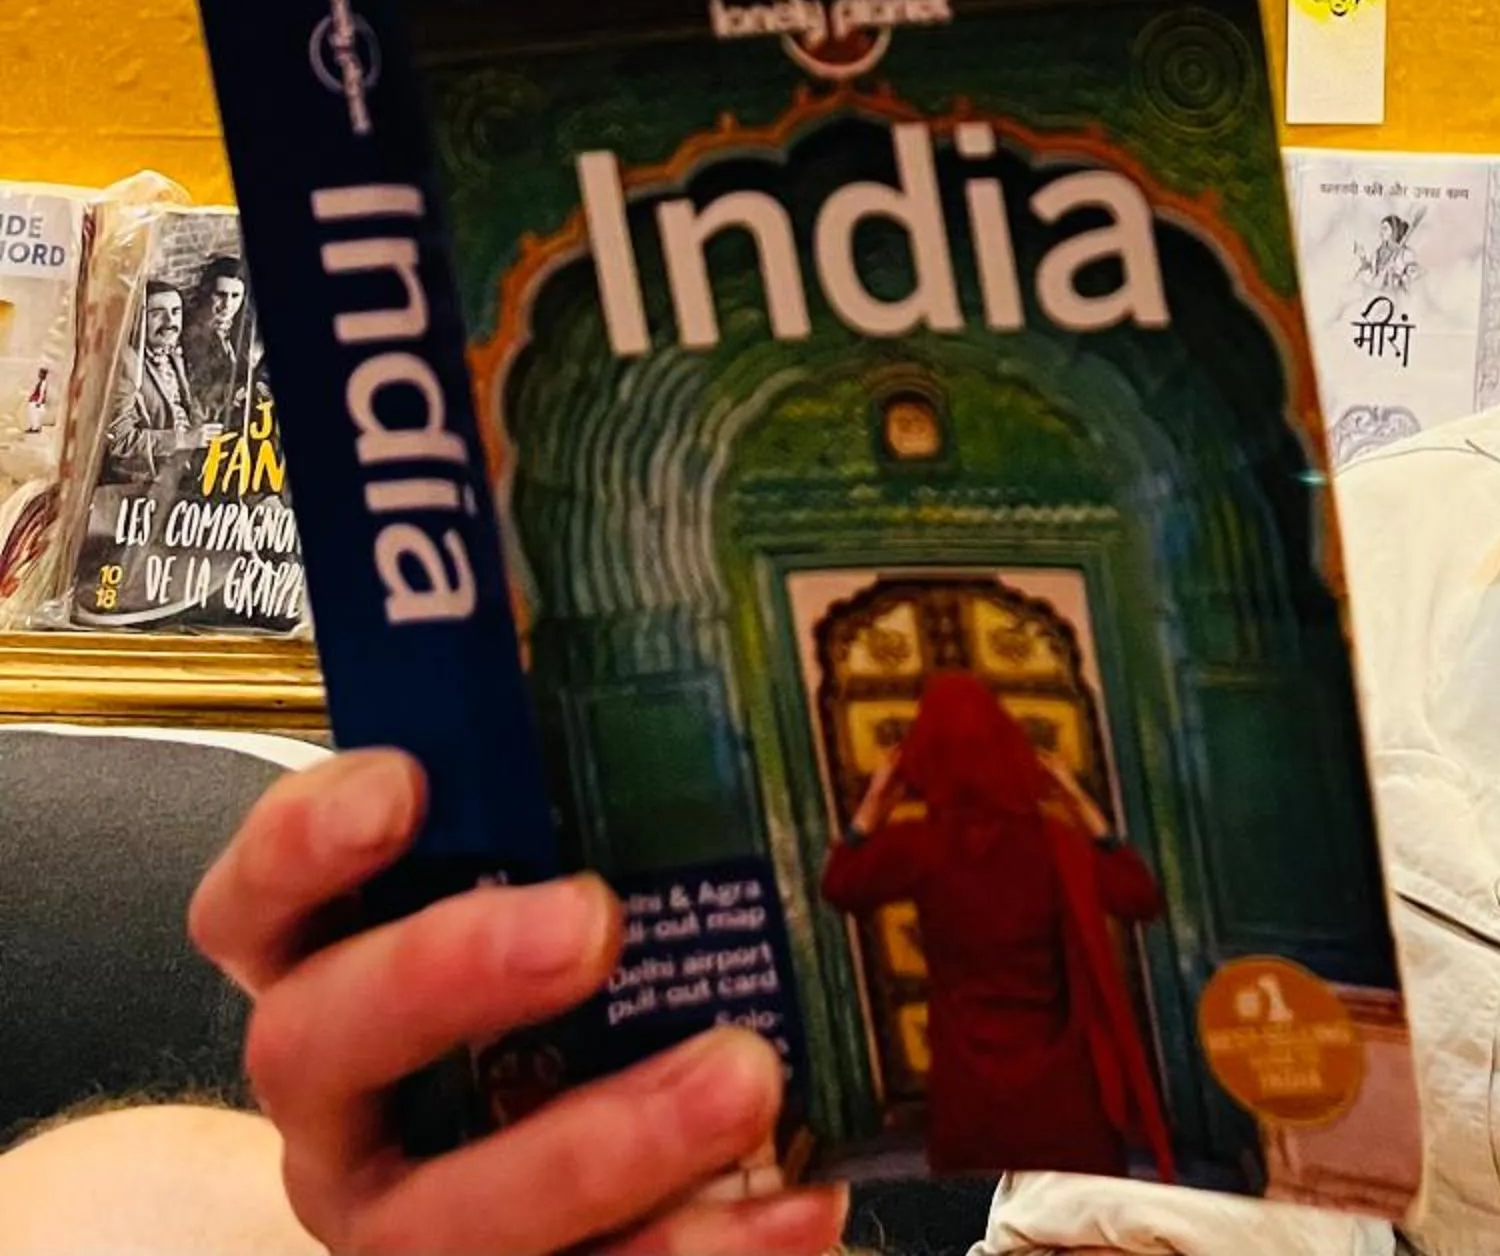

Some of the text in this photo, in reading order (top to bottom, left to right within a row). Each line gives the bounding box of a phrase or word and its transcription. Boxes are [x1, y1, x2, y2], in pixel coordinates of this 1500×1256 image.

[577, 120, 1171, 357] India
[310, 181, 481, 626] India
[200, 431, 285, 497] FAN
[115, 497, 156, 546] LES
[95, 587, 117, 609] 18
[100, 566, 122, 585] 10
[146, 555, 177, 604] DE
[185, 556, 211, 609] LA
[699, 879, 762, 908] Agra
[706, 905, 767, 932] map
[682, 940, 773, 980] airport
[607, 987, 656, 1027] pull
[717, 967, 780, 998] card
